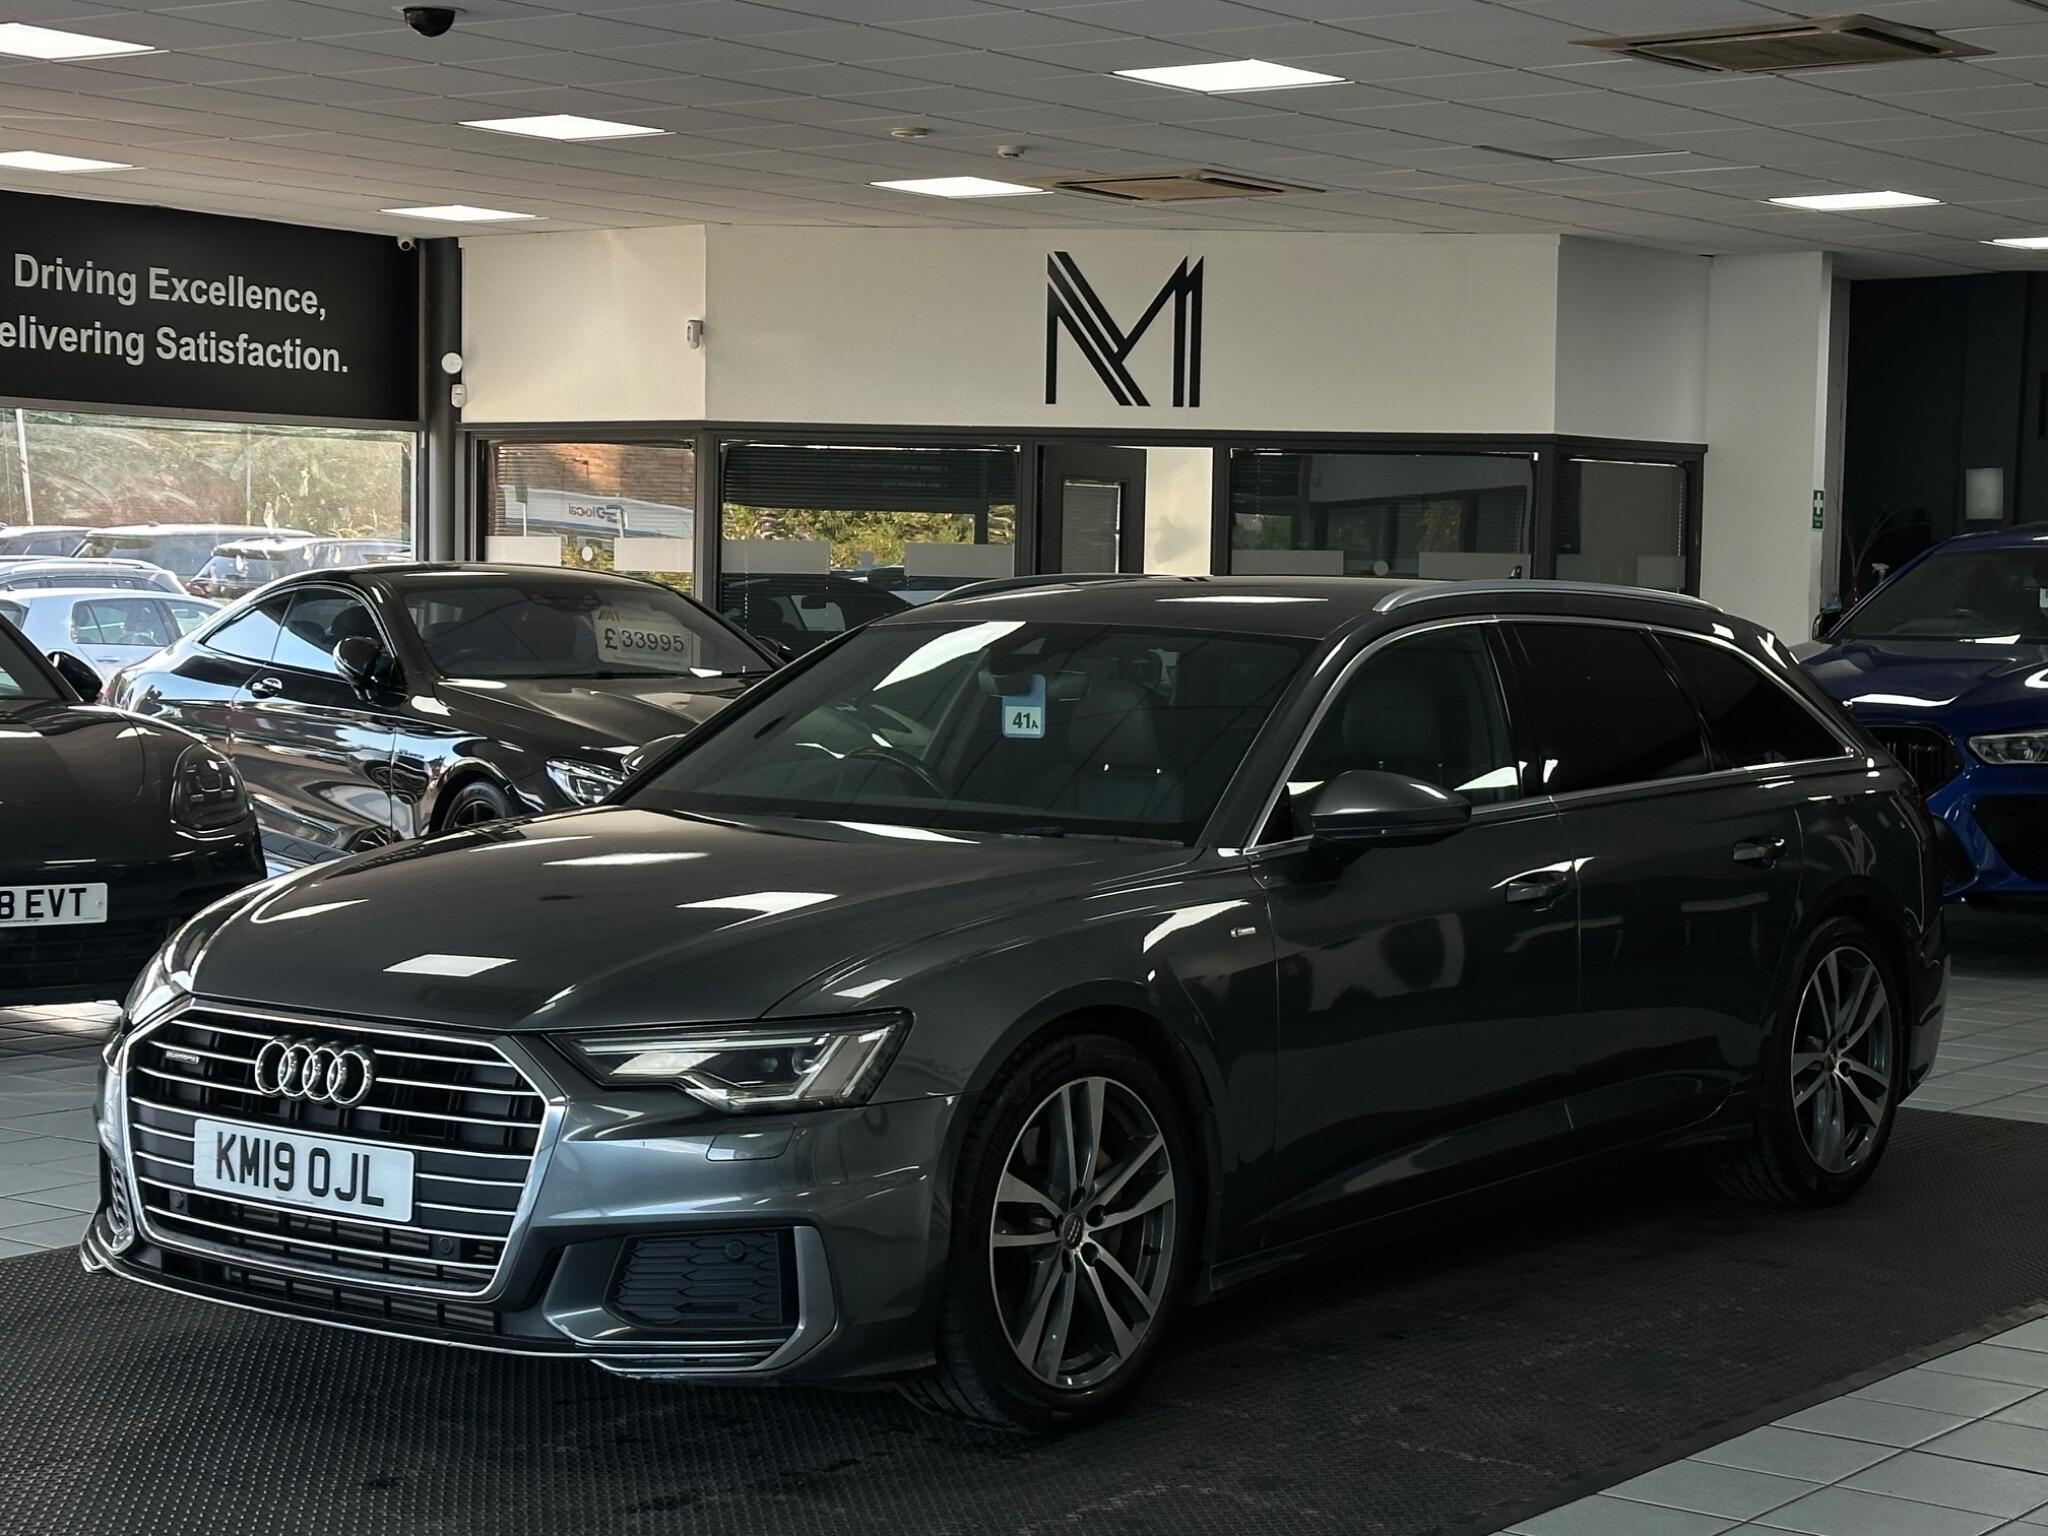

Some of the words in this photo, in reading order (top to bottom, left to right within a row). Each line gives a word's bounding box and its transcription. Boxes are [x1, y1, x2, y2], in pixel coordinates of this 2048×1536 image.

[14, 253, 137, 306] Driving
[149, 267, 326, 321] Excellence,
[0, 315, 145, 366] elivering
[156, 326, 349, 373] Satisfaction.
[604, 627, 684, 653] £33995
[25, 887, 87, 918] EVT
[216, 1131, 295, 1192] KM19
[308, 1147, 384, 1207] OJL
